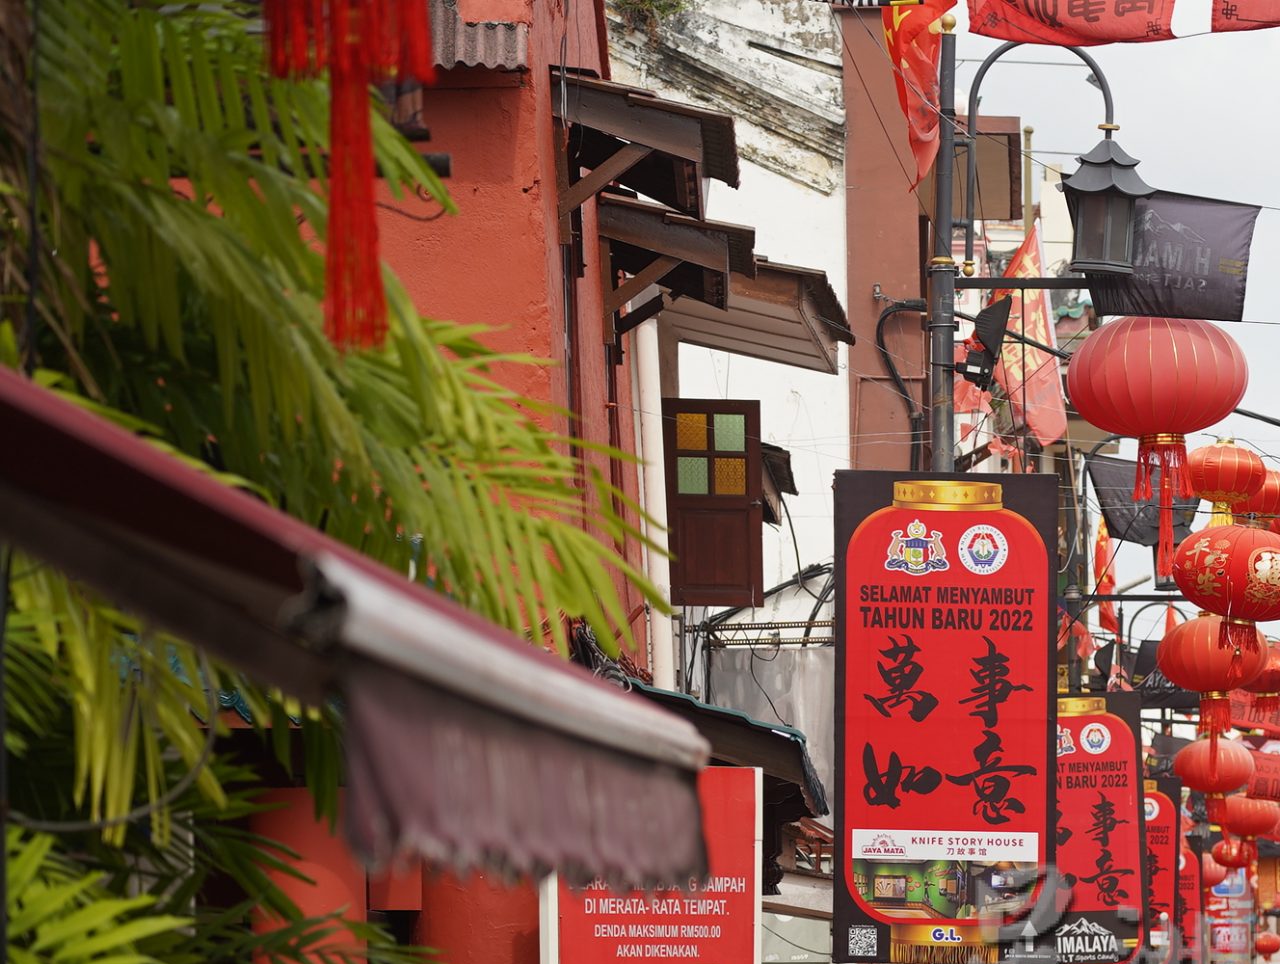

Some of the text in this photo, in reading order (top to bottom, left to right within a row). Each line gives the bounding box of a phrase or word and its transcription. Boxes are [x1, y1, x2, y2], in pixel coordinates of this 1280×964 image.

[860, 585, 1035, 605] SELAMAT MENYAMBUT
[860, 606, 1033, 631] TAHUN BARU 2022
[1068, 761, 1128, 773] MENYAMBUT
[1066, 776, 1097, 790] BARU
[1101, 774, 1128, 789] 2022
[911, 836, 1025, 847] KNIFE STORY HOUSE
[1150, 835, 1169, 845] 2022
[862, 847, 882, 855] JAYA
[585, 898, 596, 914] DI
[652, 899, 681, 915] RATA
[683, 899, 730, 916] TEMPAT.
[594, 924, 721, 938] DENDA MAKSIMUM RM500.00
[931, 927, 963, 942] G.L.
[616, 945, 700, 958] AKAN DIKENAKAN.
[1056, 935, 1118, 954] IMALAYA
